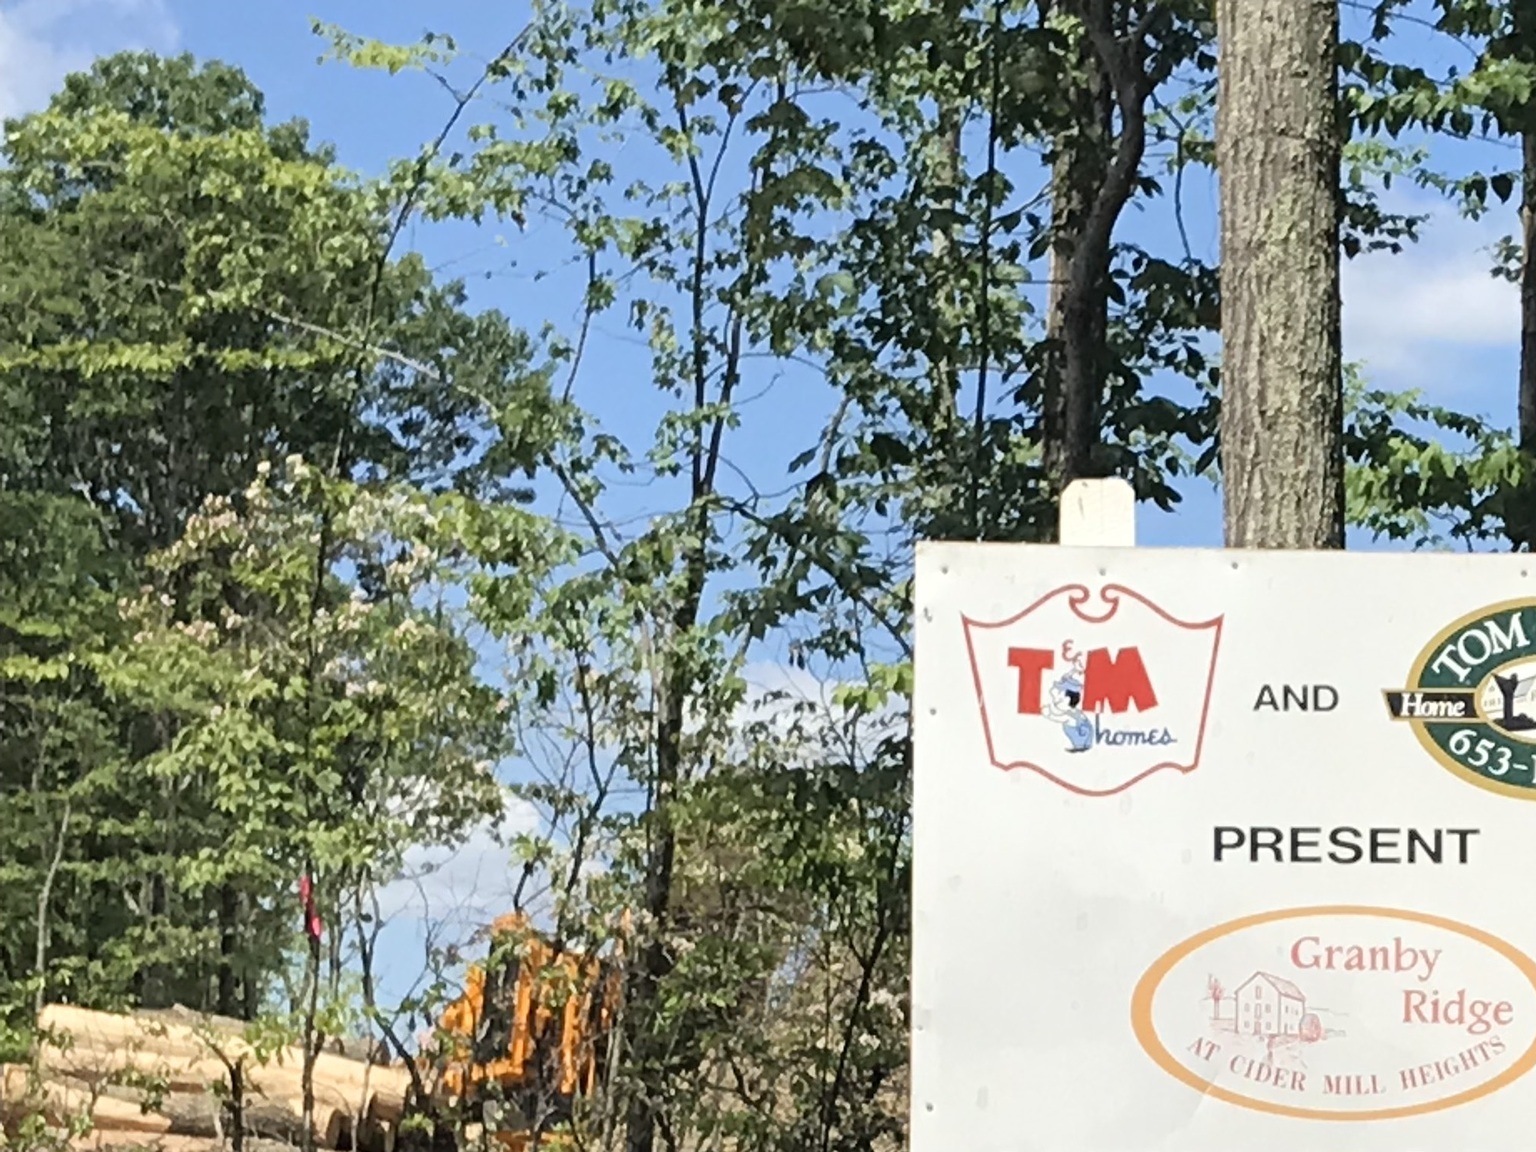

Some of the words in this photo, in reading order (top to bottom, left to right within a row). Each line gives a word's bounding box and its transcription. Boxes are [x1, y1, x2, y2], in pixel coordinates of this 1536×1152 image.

[1432, 612, 1530, 683] TOM
[1254, 685, 1338, 712] AND
[1400, 693, 1466, 718] Home
[1094, 712, 1178, 745] homes
[1212, 826, 1480, 864] PRESENT
[1290, 936, 1442, 982] Granby
[1402, 989, 1514, 1034] Ridge
[1186, 1036, 1221, 1061] AT
[1229, 1054, 1306, 1092] CIDER
[1322, 1074, 1387, 1095] MILL
[1399, 1035, 1506, 1090] HEIGHTS
